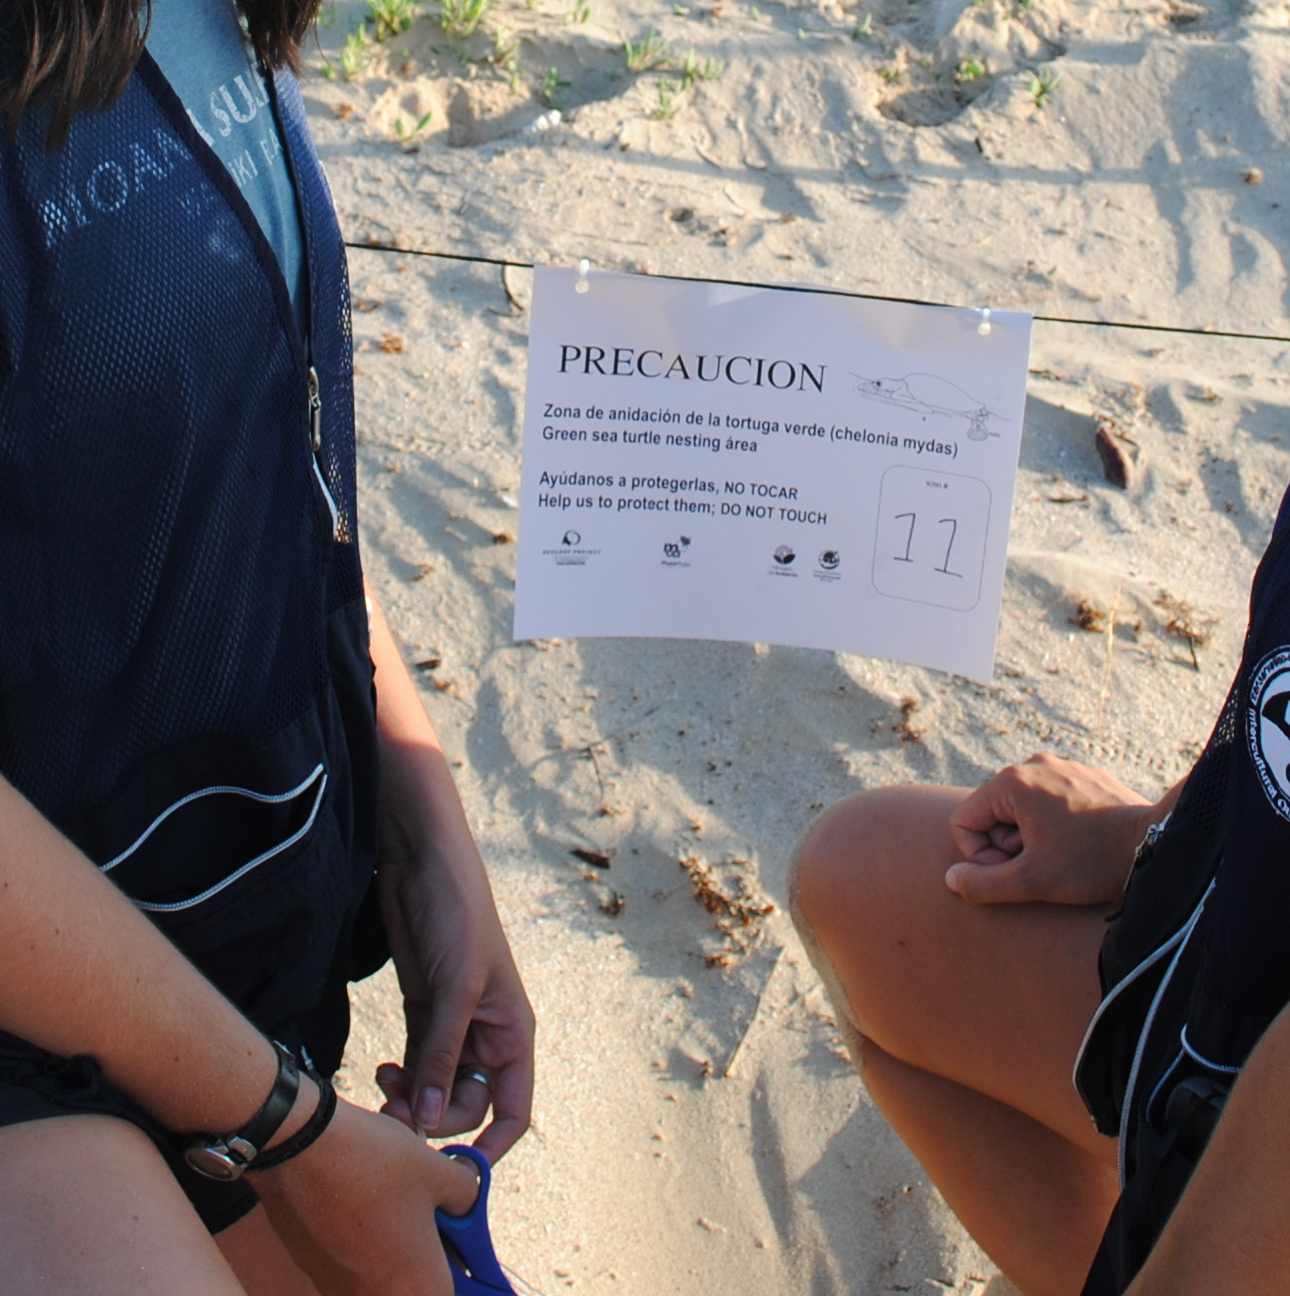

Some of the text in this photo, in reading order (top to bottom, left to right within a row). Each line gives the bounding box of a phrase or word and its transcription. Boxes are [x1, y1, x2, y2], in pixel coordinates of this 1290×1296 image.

[557, 344, 828, 393] PRECAUCION
[542, 425, 758, 453] Green sea turtle nesting área
[543, 403, 959, 459] Zona de anidación de la tortuga verde (chelonia mydas)
[539, 470, 799, 500] Ayúdanos a protegerlas, NO TOCAR
[538, 493, 828, 525] Help us to protect them; DO NOT TOUCH
[893, 512, 964, 579] 11
